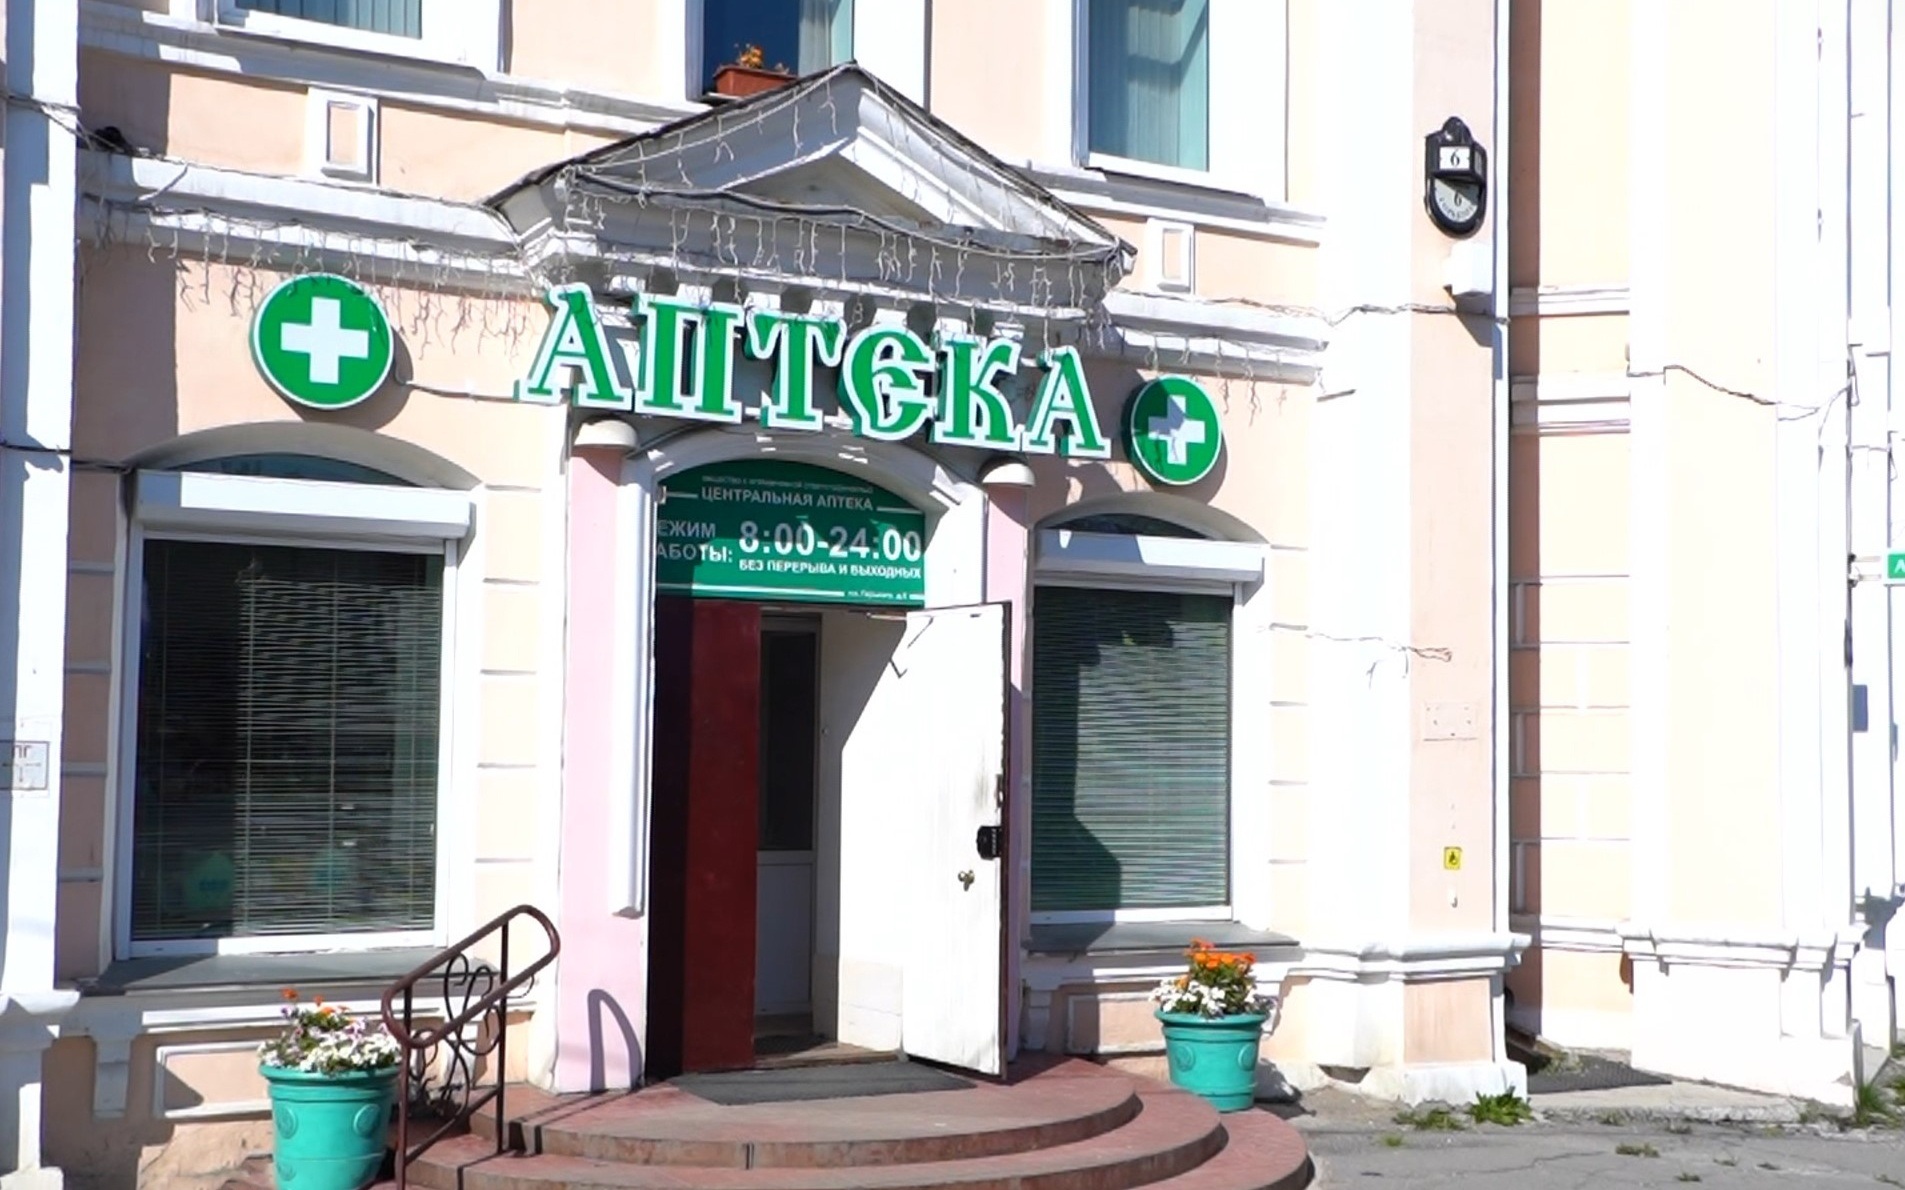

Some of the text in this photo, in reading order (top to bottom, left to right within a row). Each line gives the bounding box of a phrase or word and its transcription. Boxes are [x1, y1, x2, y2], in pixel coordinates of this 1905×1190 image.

[1450, 148, 1460, 167] 6
[514, 284, 1111, 459] АПТЕКА
[701, 487, 813, 506] ЦЕНТРАЛЬНАЯ
[816, 494, 873, 511] АПТЕКА
[657, 519, 716, 538] ЕЖИМ
[657, 541, 733, 563] АБОТЫ:
[739, 520, 922, 562] 8:00-24:00
[739, 558, 922, 579] БЕЗ ПЕРЕРЫВА И ВЫХОДНЫХ
